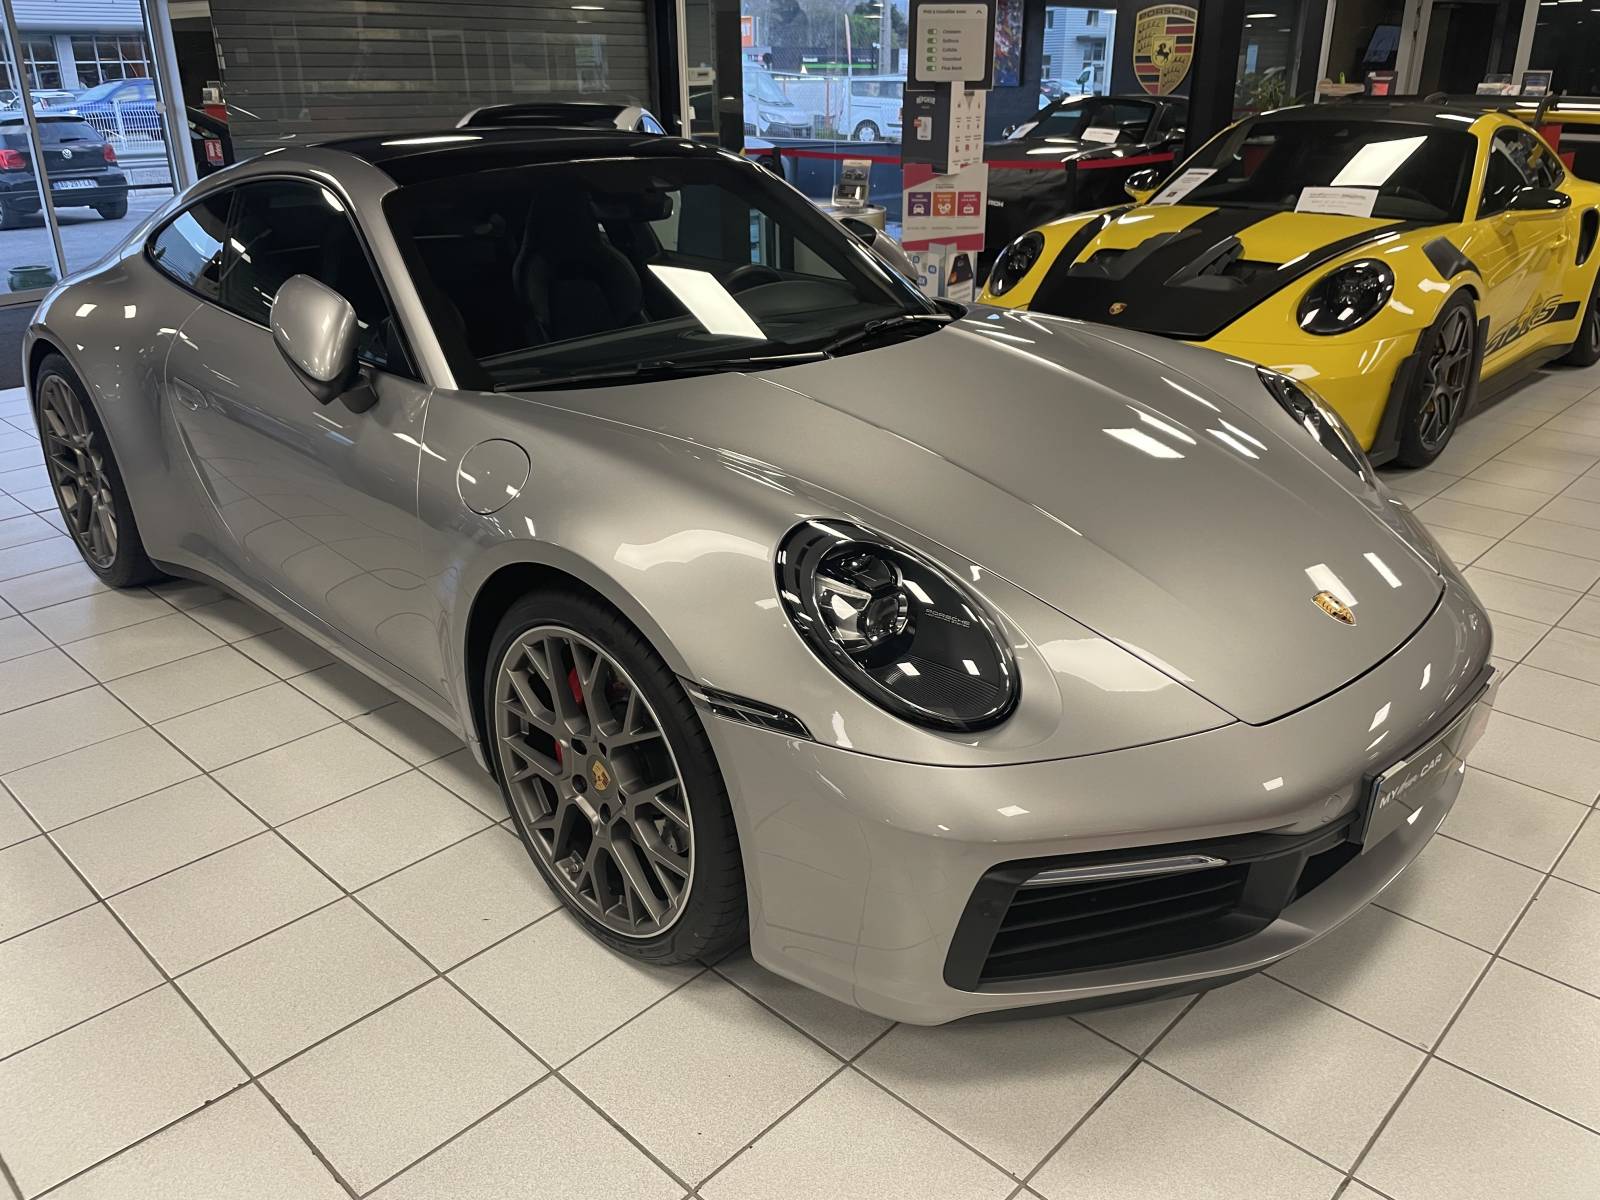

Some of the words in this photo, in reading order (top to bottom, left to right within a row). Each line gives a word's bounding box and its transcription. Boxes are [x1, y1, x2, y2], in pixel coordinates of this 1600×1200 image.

[1139, 7, 1196, 20] PORSCHE
[925, 608, 971, 625] PORSCHE
[1420, 752, 1443, 777] CAR
